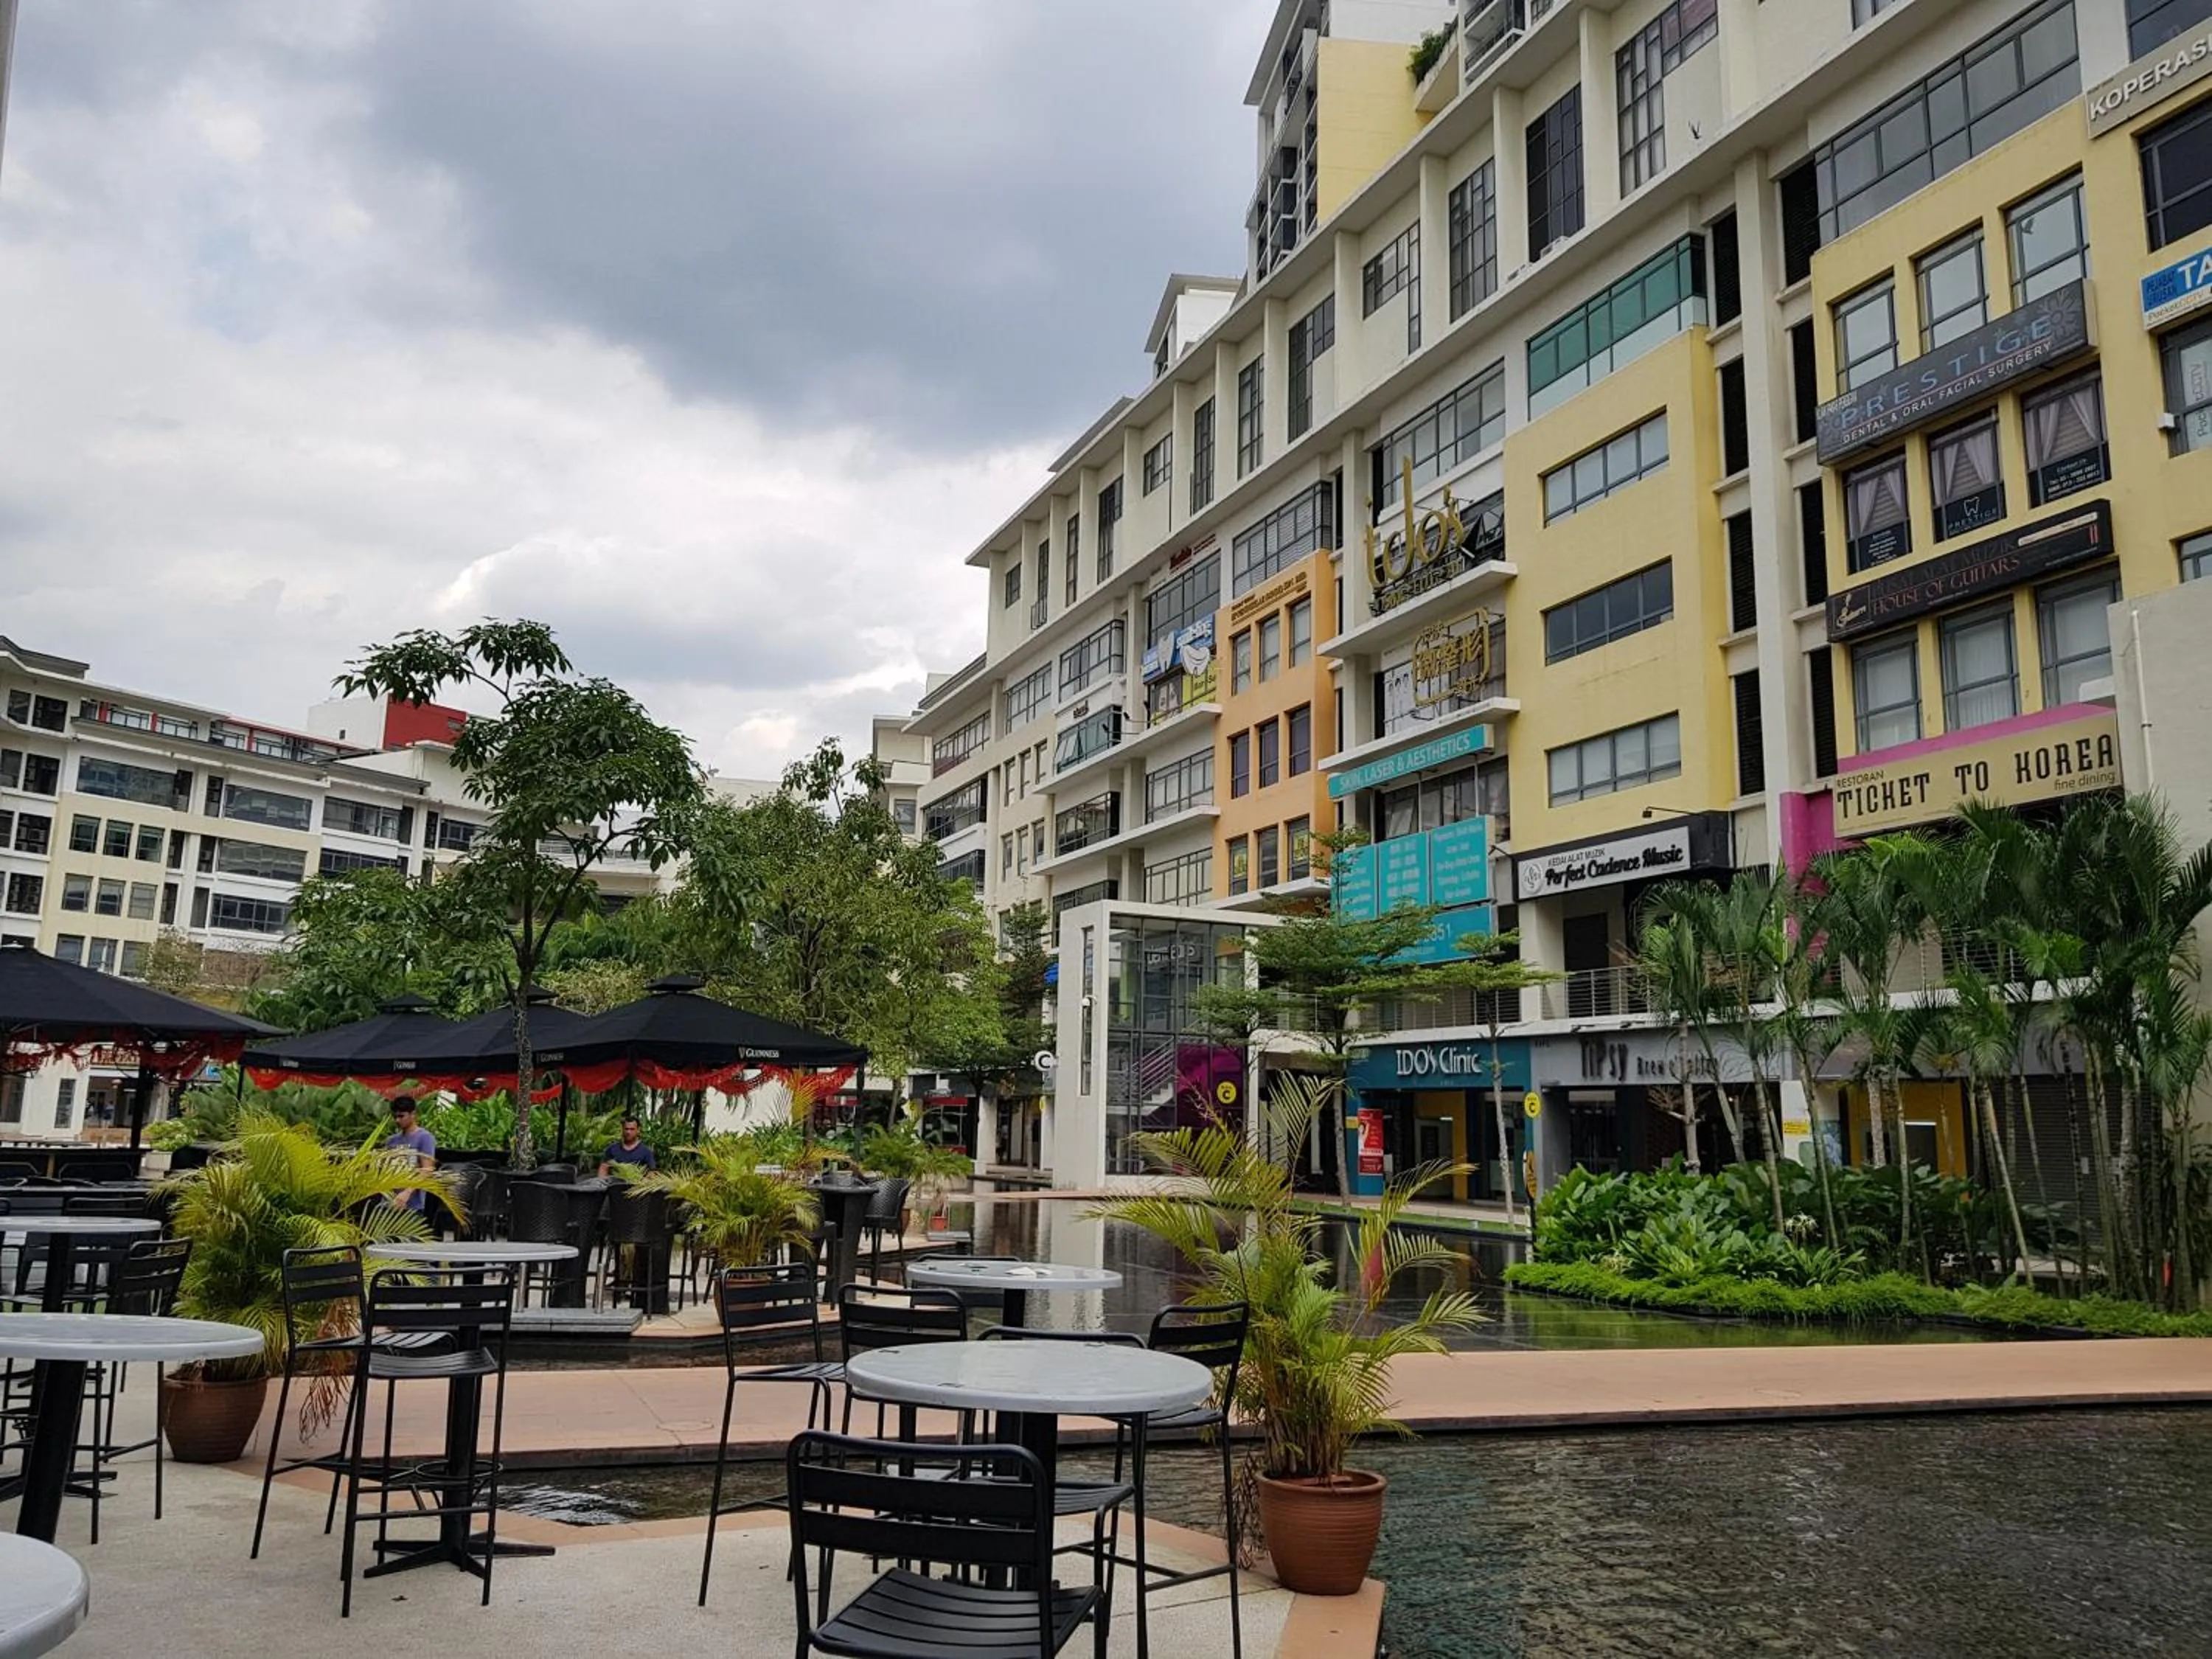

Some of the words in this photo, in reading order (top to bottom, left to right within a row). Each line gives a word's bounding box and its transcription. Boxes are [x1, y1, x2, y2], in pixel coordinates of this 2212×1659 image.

[1841, 315, 2051, 429] PRESTIGE
[1843, 420, 1886, 443] DENTAL
[1891, 412, 1897, 422] &
[1902, 397, 1934, 417] ORAL
[1939, 376, 1982, 399] FACIAL
[1988, 341, 2053, 378] SURGERY
[1873, 590, 1918, 615] HOUSE
[1925, 577, 1943, 598] OF
[1950, 555, 2020, 588] GUITARS
[1365, 761, 1394, 782] LASER
[1406, 733, 1470, 768] AESTHETICS
[1837, 772, 1930, 819] TICKET
[1955, 760, 1989, 796] TO
[2014, 734, 2114, 785] KOREA
[1837, 770, 1884, 788] RESTORAN
[2054, 778, 2076, 791] fine
[2079, 771, 2115, 786] dining
[1545, 863, 1586, 888] Perfect
[1587, 855, 1641, 878] Cadence
[1642, 844, 1683, 868] Music
[1548, 854, 1567, 866] KEDAI
[1567, 852, 1585, 863] ALAT
[1585, 848, 1605, 860] MUZIK
[745, 1047, 779, 1058] GUINNESS
[1038, 1054, 1050, 1068] C
[1439, 1046, 1484, 1074] Clinic
